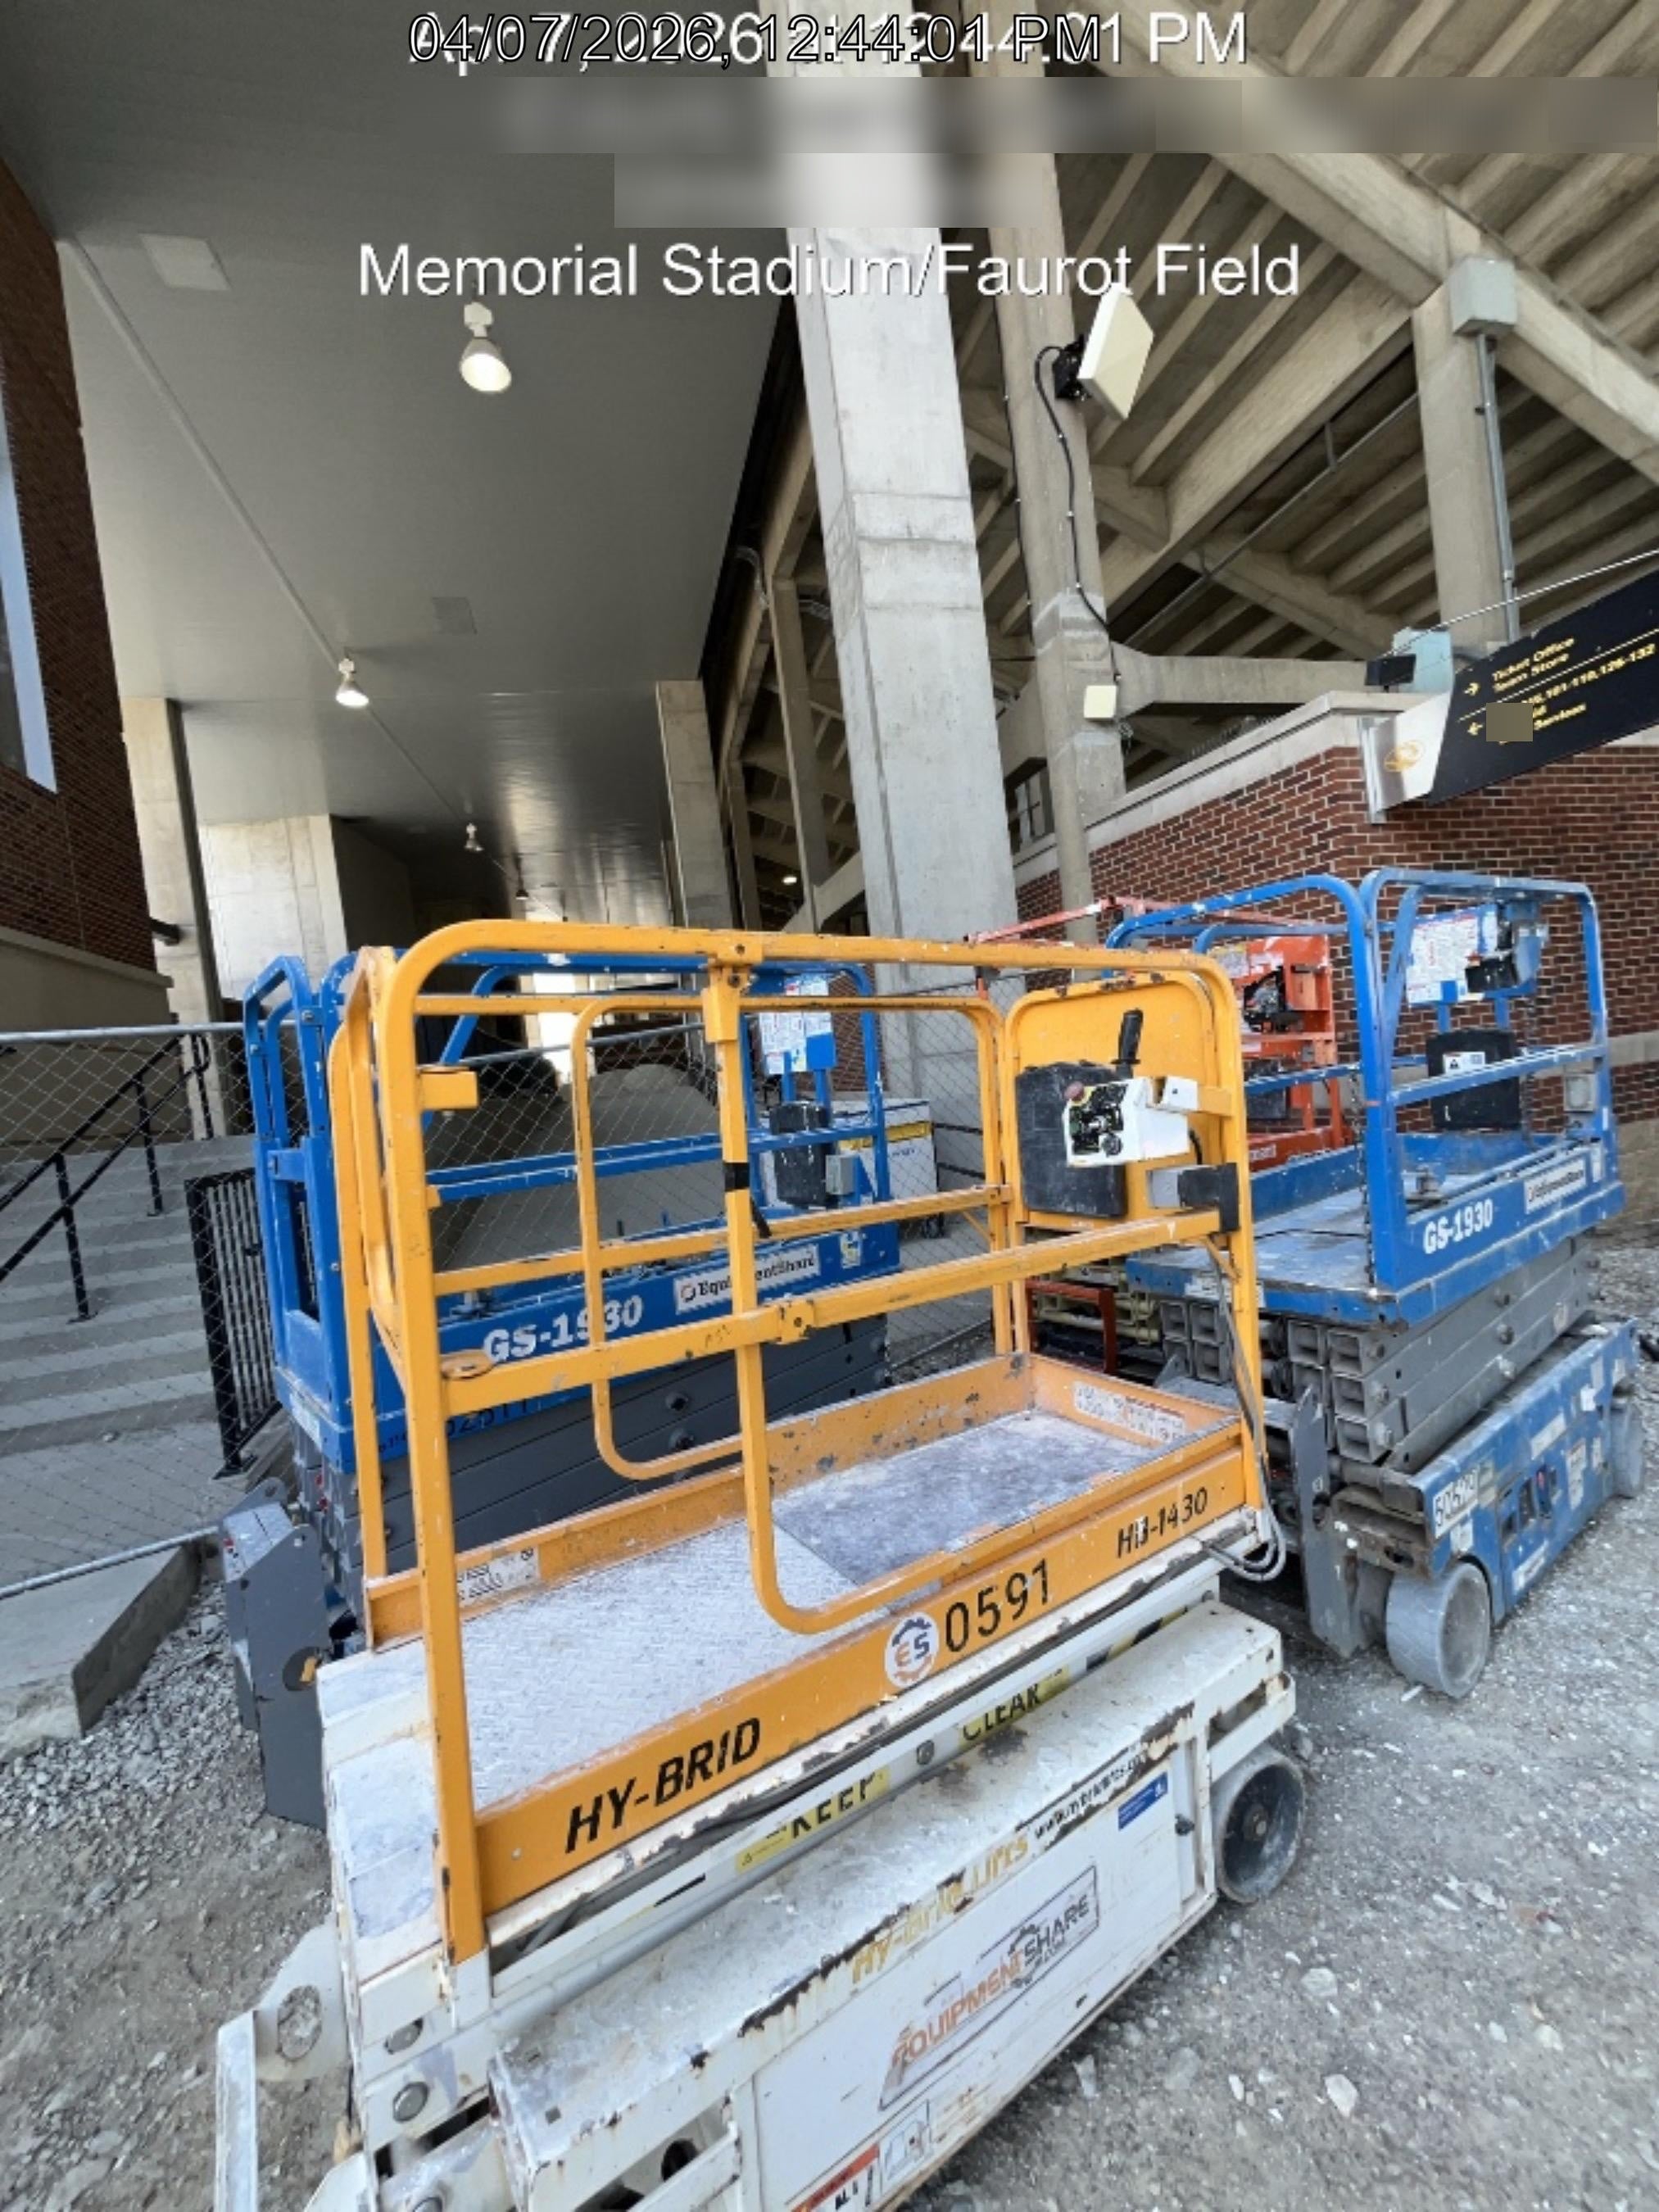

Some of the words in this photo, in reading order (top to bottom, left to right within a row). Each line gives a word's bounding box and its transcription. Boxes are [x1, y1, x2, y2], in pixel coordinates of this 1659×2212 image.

[1422, 1198, 1494, 1255] GS-1930
[945, 1558, 1049, 1653] 0591
[565, 1717, 760, 1854] HY-BRID
